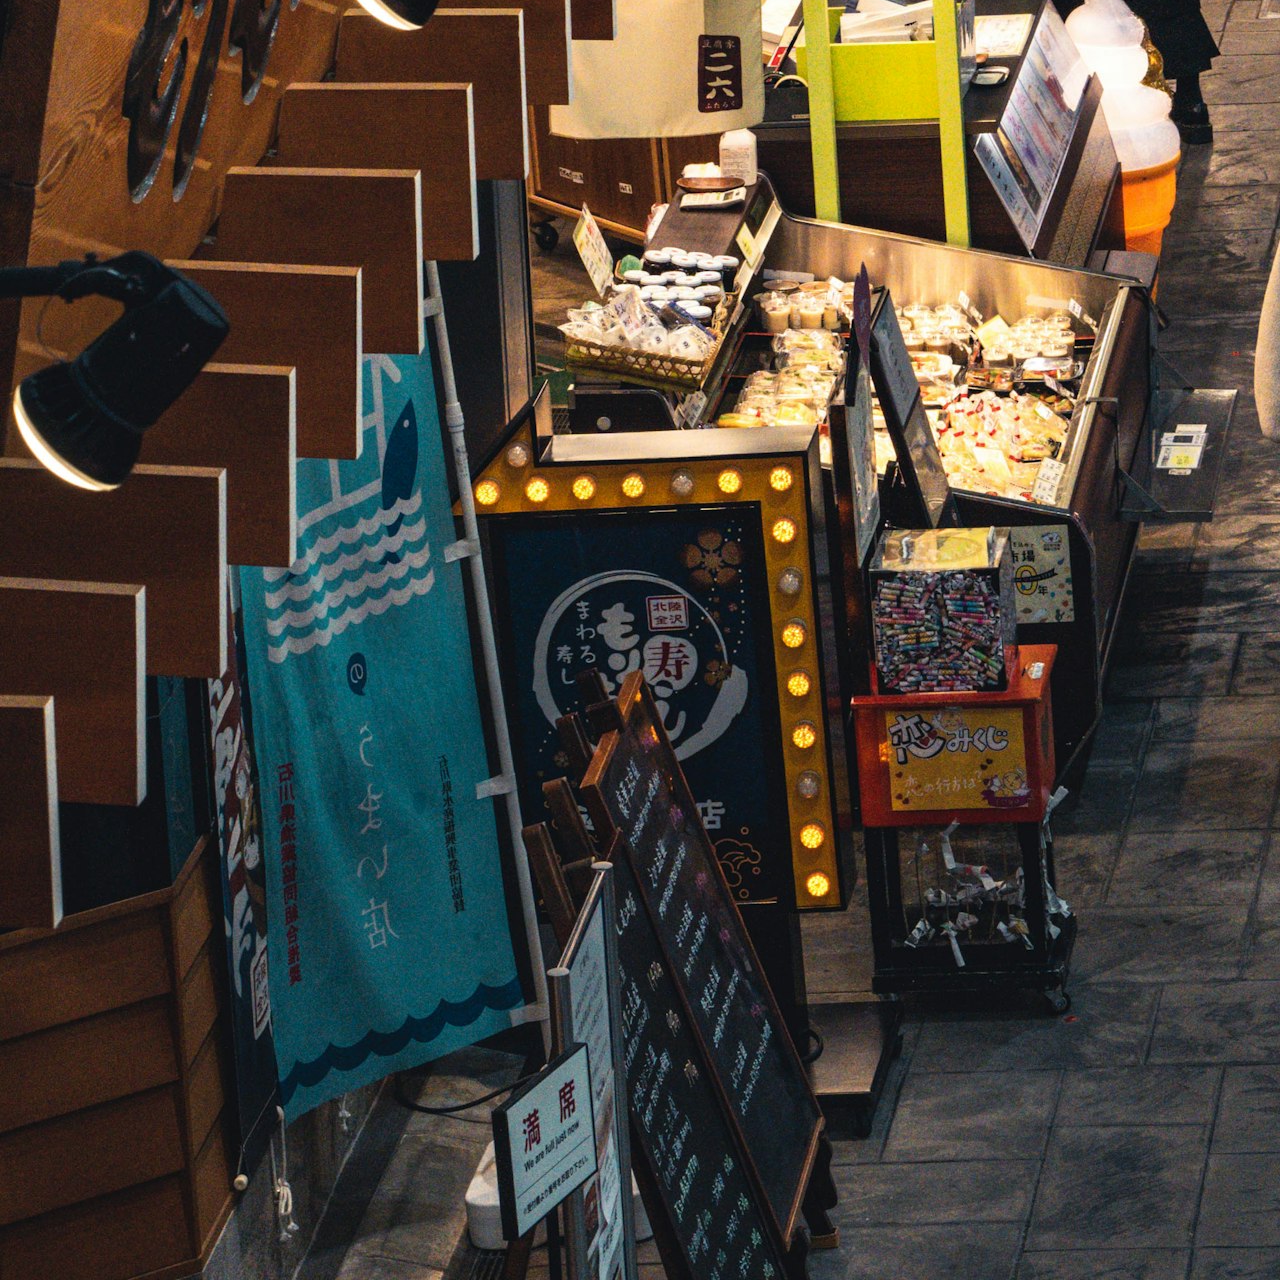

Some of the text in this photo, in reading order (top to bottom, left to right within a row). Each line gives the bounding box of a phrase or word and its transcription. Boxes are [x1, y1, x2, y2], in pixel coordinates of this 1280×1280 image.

[704, 52, 736, 100] 二六
[575, 600, 597, 665] まわる
[555, 645, 577, 686] 寿し
[889, 714, 1009, 764] 恋みくじ
[521, 1078, 578, 1154] 満席
